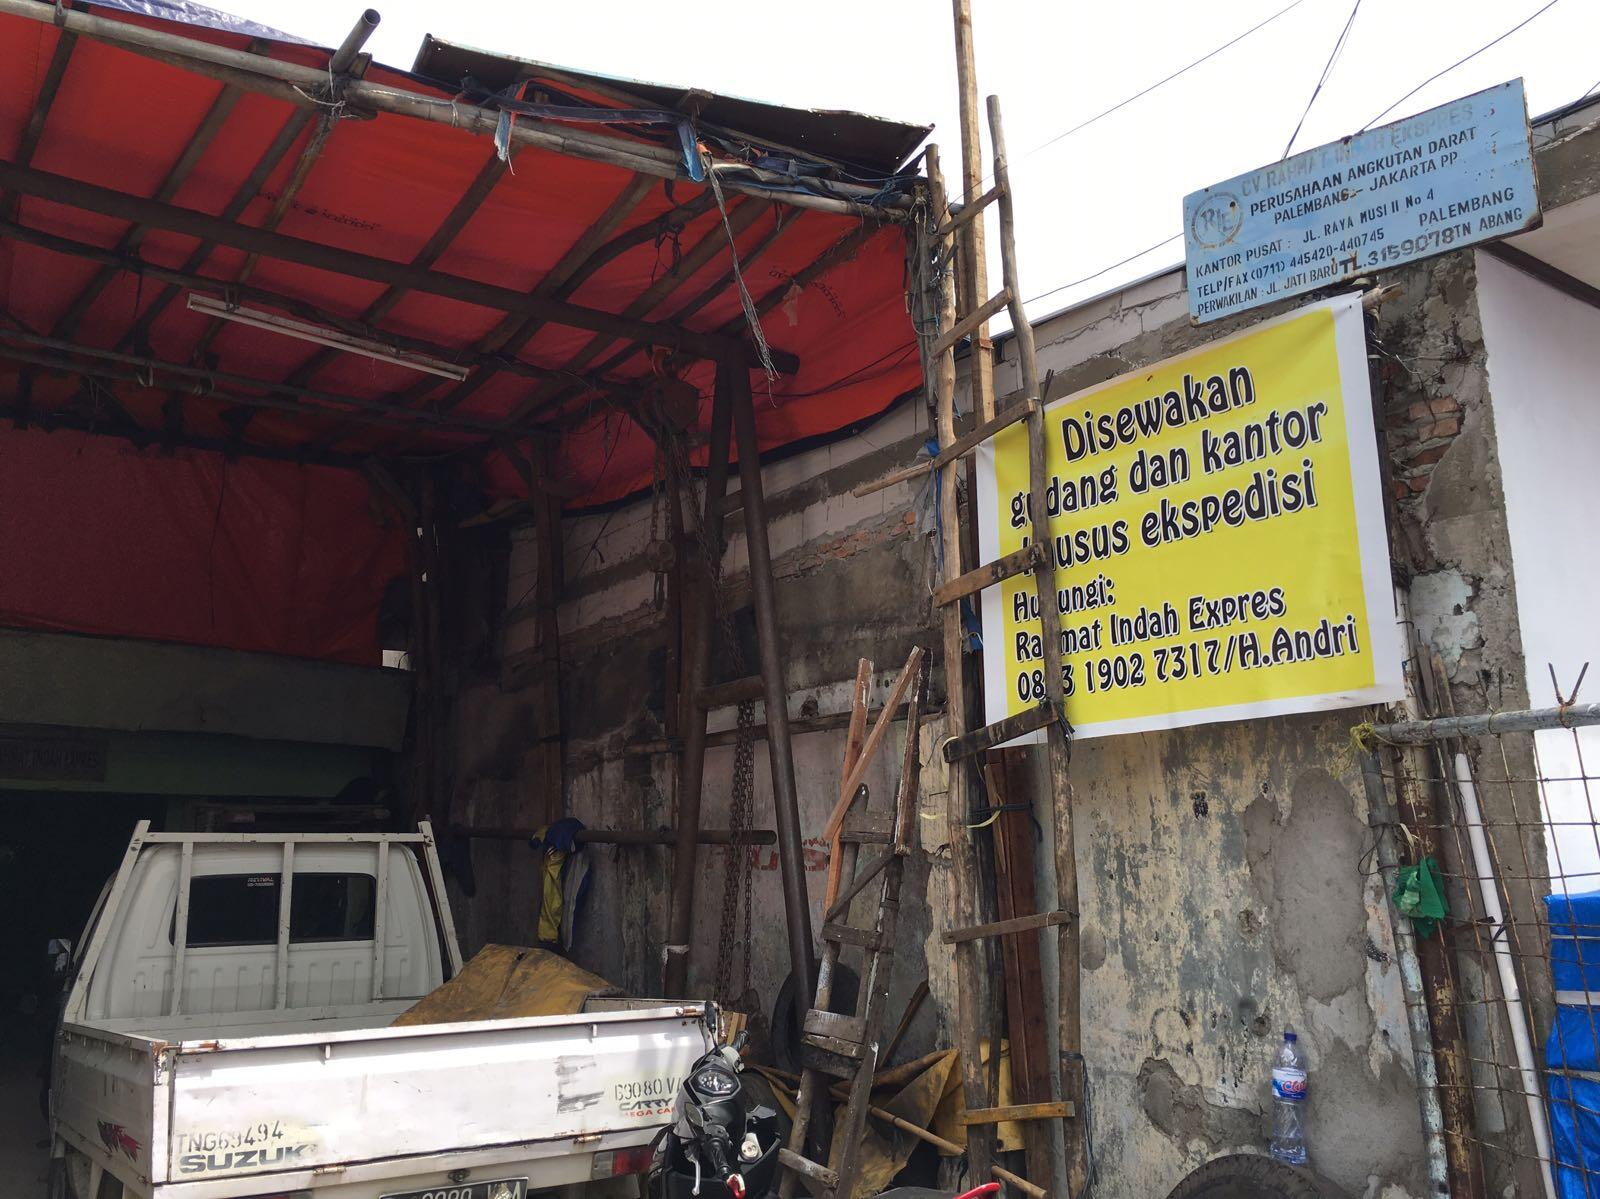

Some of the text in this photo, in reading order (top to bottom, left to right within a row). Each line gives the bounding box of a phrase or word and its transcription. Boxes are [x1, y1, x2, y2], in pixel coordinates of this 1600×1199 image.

[1250, 126, 1476, 216] PERUSAHAAN ANGKUTAN DARAT
[1274, 188, 1349, 224] PALEMBANG
[1370, 159, 1436, 191] JAKARTA
[1441, 151, 1458, 168] PP
[1196, 253, 1241, 278] KANTOR
[1246, 239, 1283, 262] PUSAT
[1303, 230, 1320, 244] JL.
[1324, 216, 1354, 235] RAYA
[1360, 205, 1387, 224] MUSI
[1406, 194, 1421, 209] No
[1426, 188, 1434, 202] 4
[1197, 287, 1258, 317] PERWAKILAN
[1266, 283, 1280, 295] JL.
[1284, 273, 1307, 290] JATI
[1310, 261, 1338, 281] BARU
[1479, 207, 1523, 231] ABANG
[1290, 228, 1384, 268] 445420-440745
[1419, 187, 1514, 226] PALEMBANG
[1061, 364, 1255, 462] Disewakan
[1128, 447, 1190, 495] dan
[1201, 400, 1328, 475] kantor
[1021, 458, 1318, 577] usus ekspedisi
[1013, 573, 1115, 623] Huungi:
[1015, 586, 1286, 663] Ramat Indah Expres
[1017, 615, 1361, 703] 083 1902 7317/H.Andri
[619, 1097, 672, 1112] CARRY
